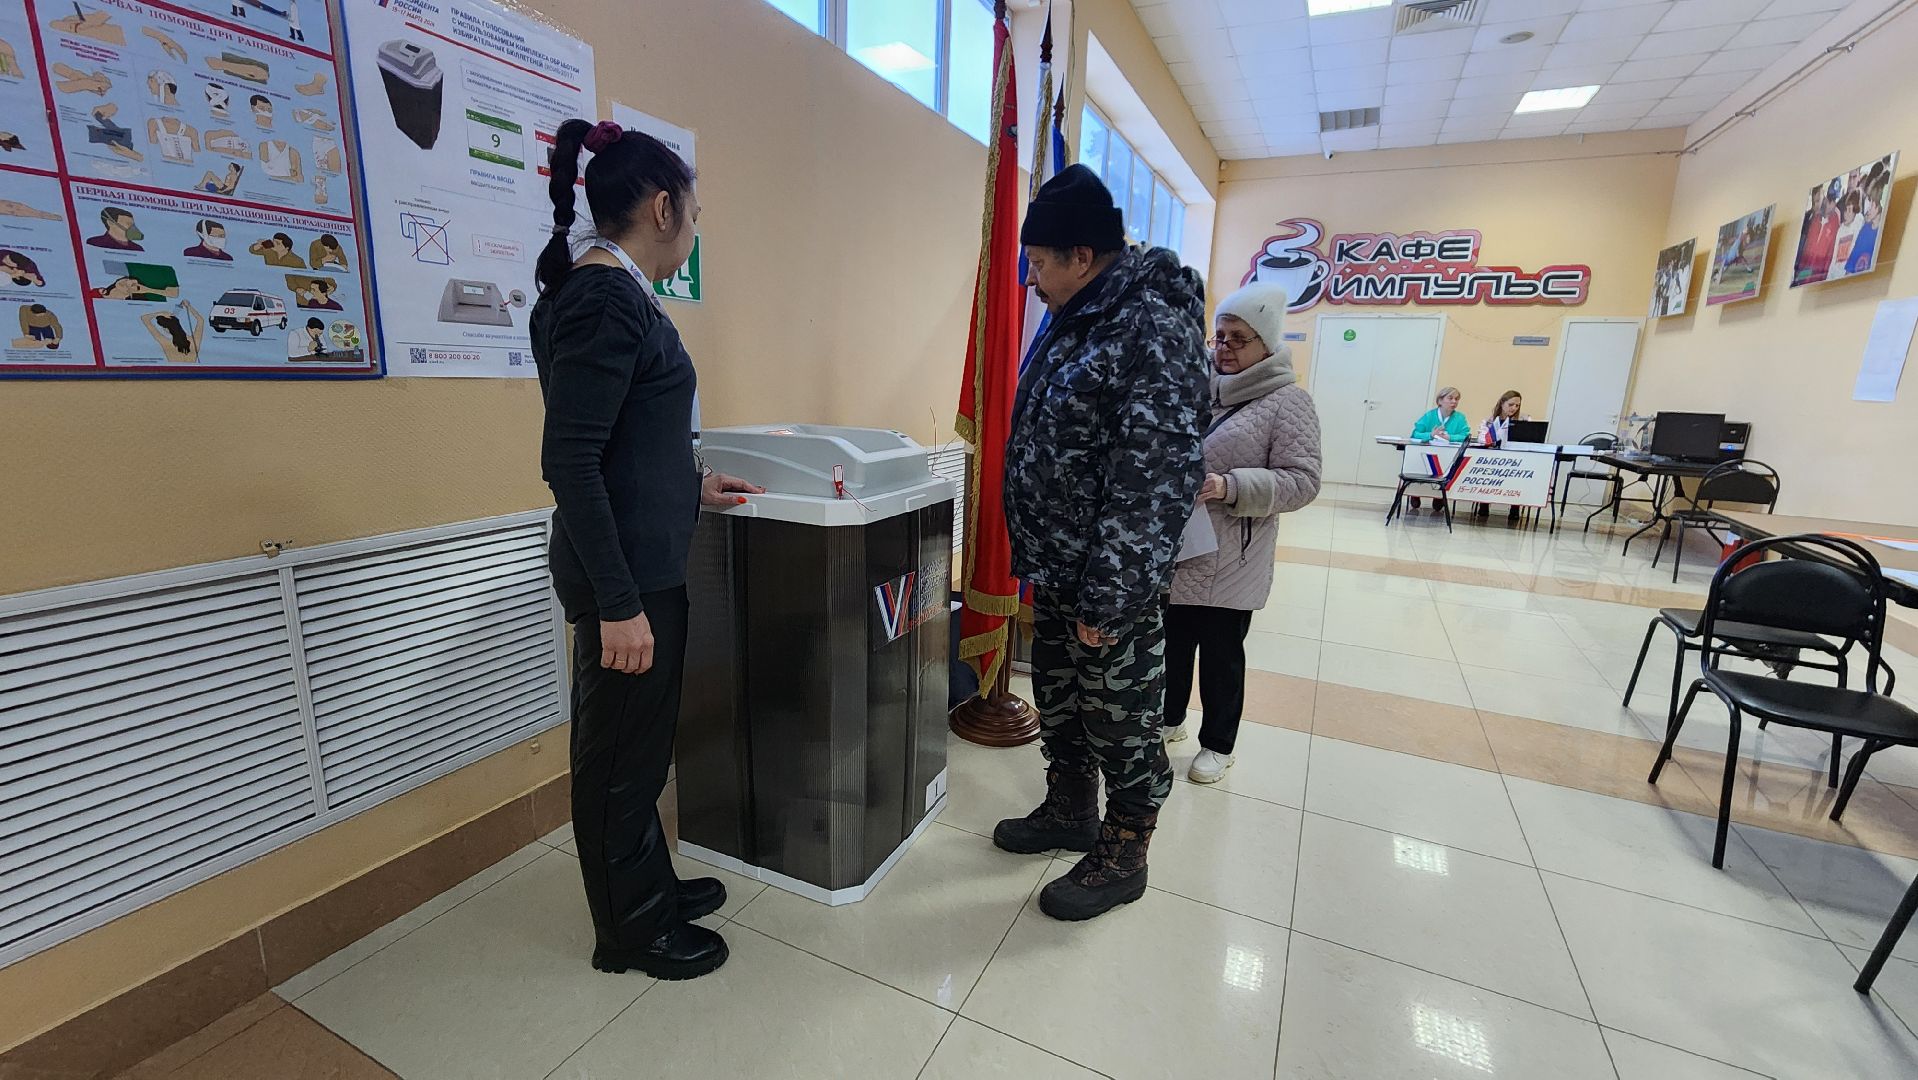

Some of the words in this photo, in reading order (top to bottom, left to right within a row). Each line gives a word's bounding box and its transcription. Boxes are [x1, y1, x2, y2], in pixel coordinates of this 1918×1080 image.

[394, 0, 422, 14] РОССИИ
[451, 7, 481, 25] ПРАВИЛА
[482, 20, 525, 43] ГОЛОСОВАНИЯ
[149, 9, 204, 32] ПОМОЩЬ
[209, 28, 233, 41] ПРИ
[237, 36, 296, 60] РАНЕНИЯХ
[453, 27, 506, 53] ИЗБИРАТЕЛЬНЫХ
[506, 48, 544, 68] БЮЛЛЕТЕНЕЙ
[457, 20, 515, 48] ИСПОЛЬЗОВАНИЕМ
[515, 43, 550, 62] КОМПЛЕКСА
[550, 57, 580, 74] ОБРАБОТКИ
[491, 133, 501, 148] 9
[76, 185, 125, 200] ПЕРВАЯ
[128, 193, 179, 208] ПОМОЩЬ
[181, 201, 204, 211] ПРИ
[206, 204, 290, 224] РАДИАЦИОННЫХ
[292, 217, 352, 233] ПОРАЖЕНИЯХ
[1336, 236, 1472, 263] КАФЕ
[1331, 270, 1583, 299] ИМПУЛЬС
[224, 307, 236, 315] 03
[434, 352, 448, 360] 800
[1475, 456, 1523, 467] ВЫБОРЫ
[1469, 466, 1535, 479] ПРЕЗИДЕНТА
[1462, 476, 1504, 487] РОССИИ
[1477, 487, 1503, 496] МАРТА
[1502, 489, 1521, 498] 2024
